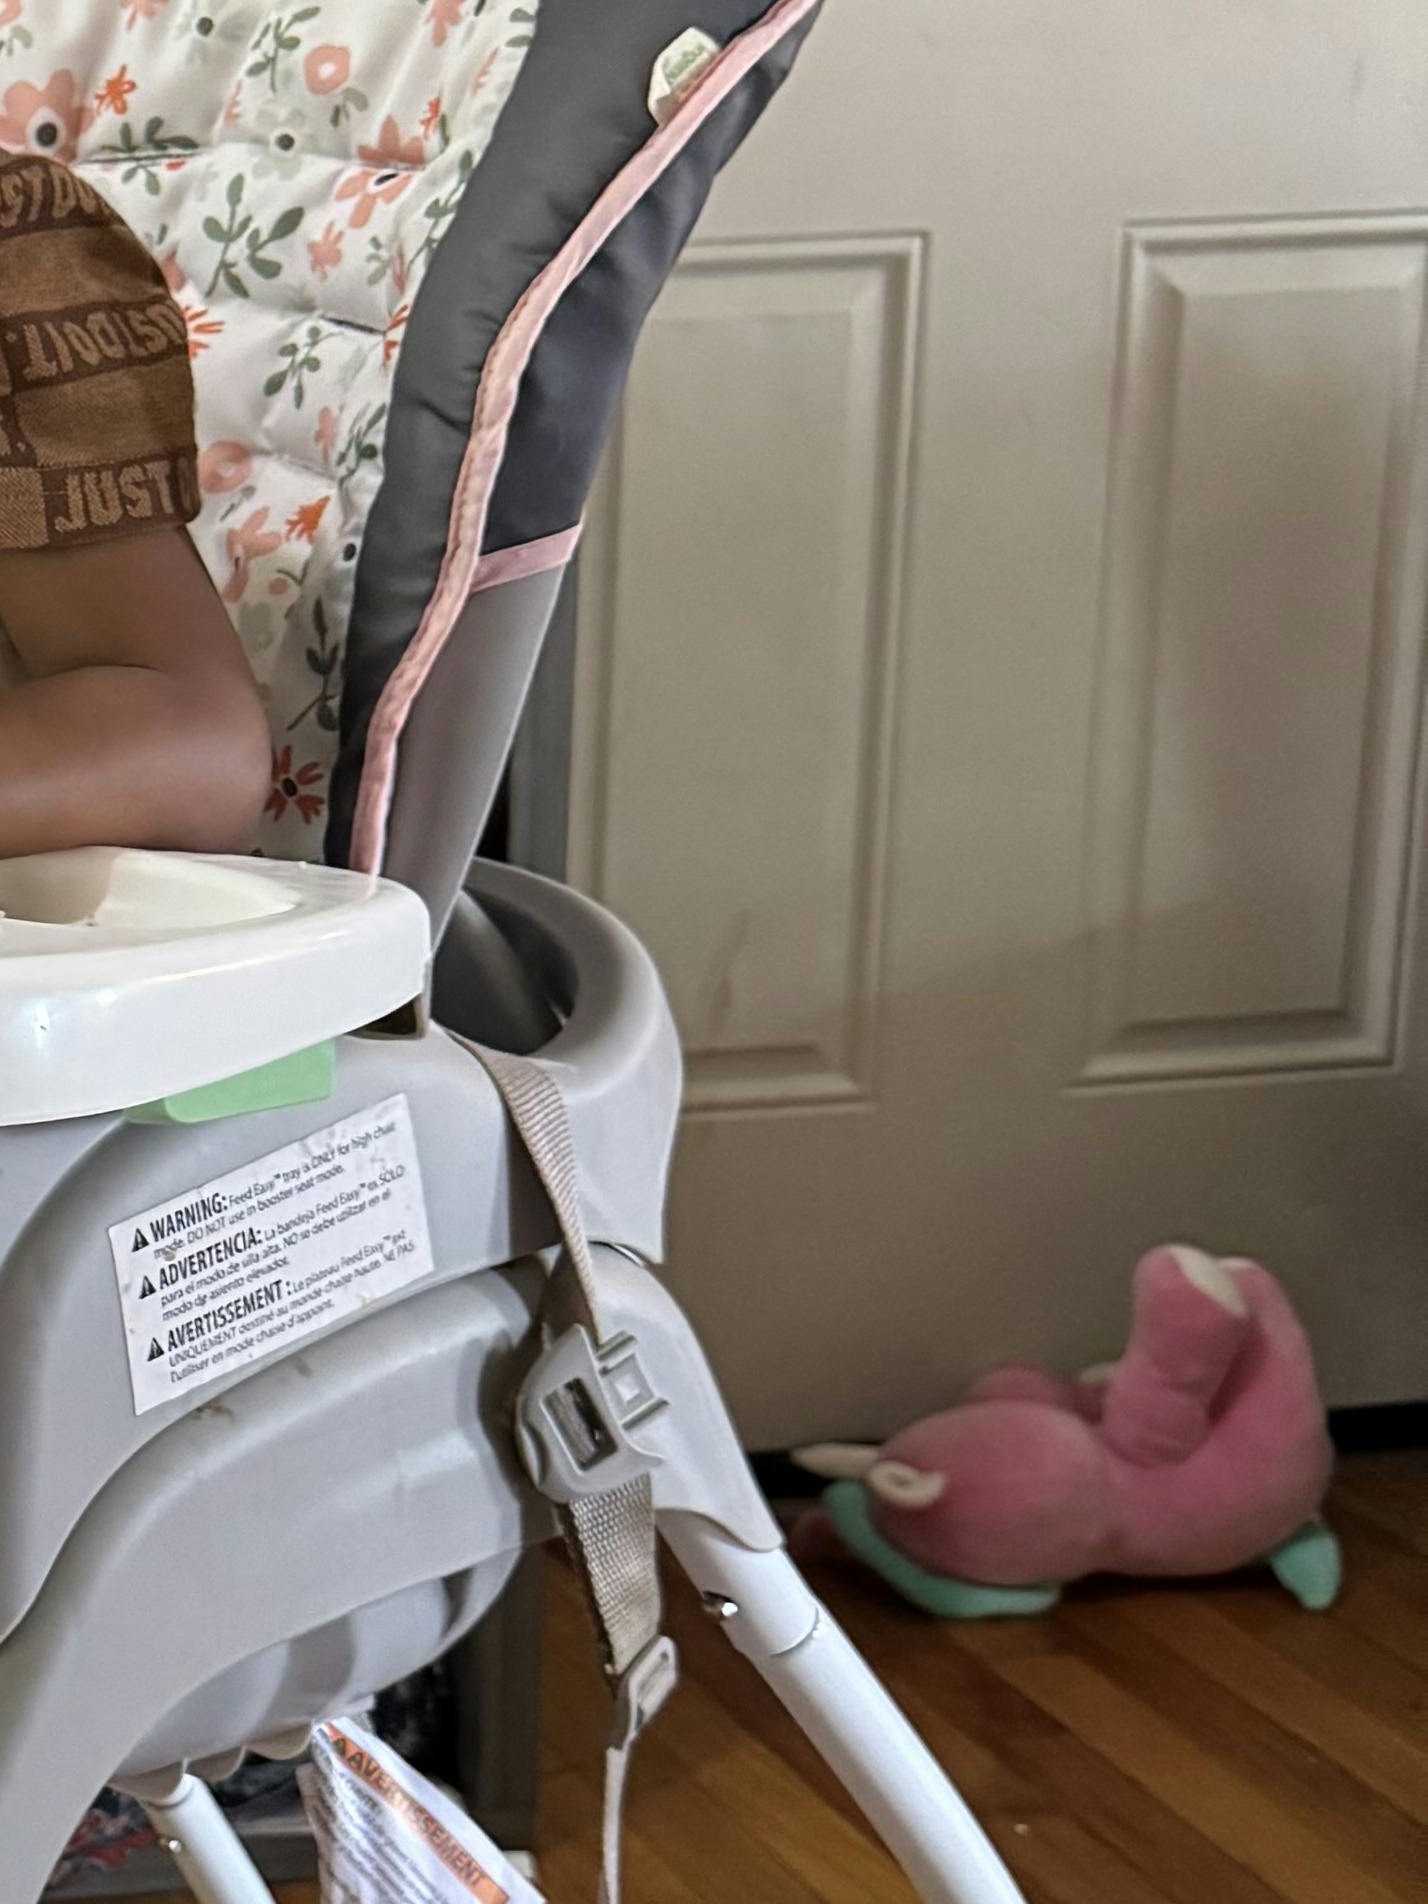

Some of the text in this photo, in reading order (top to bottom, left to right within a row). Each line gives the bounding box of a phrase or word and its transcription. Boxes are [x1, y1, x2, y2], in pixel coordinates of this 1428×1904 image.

[54, 459, 175, 534] JUST
[149, 1192, 227, 1242] WARNING:
[229, 1186, 253, 1209] Feed
[282, 1167, 300, 1184] tray
[311, 1148, 335, 1168] ONLY
[337, 1144, 350, 1156] for
[187, 1179, 315, 1244] DO NOT use in booster seat
[158, 1227, 263, 1290] ADVERTENCIA:
[282, 1231, 299, 1247] NO
[167, 1280, 283, 1353] AVERTISSEMENT
